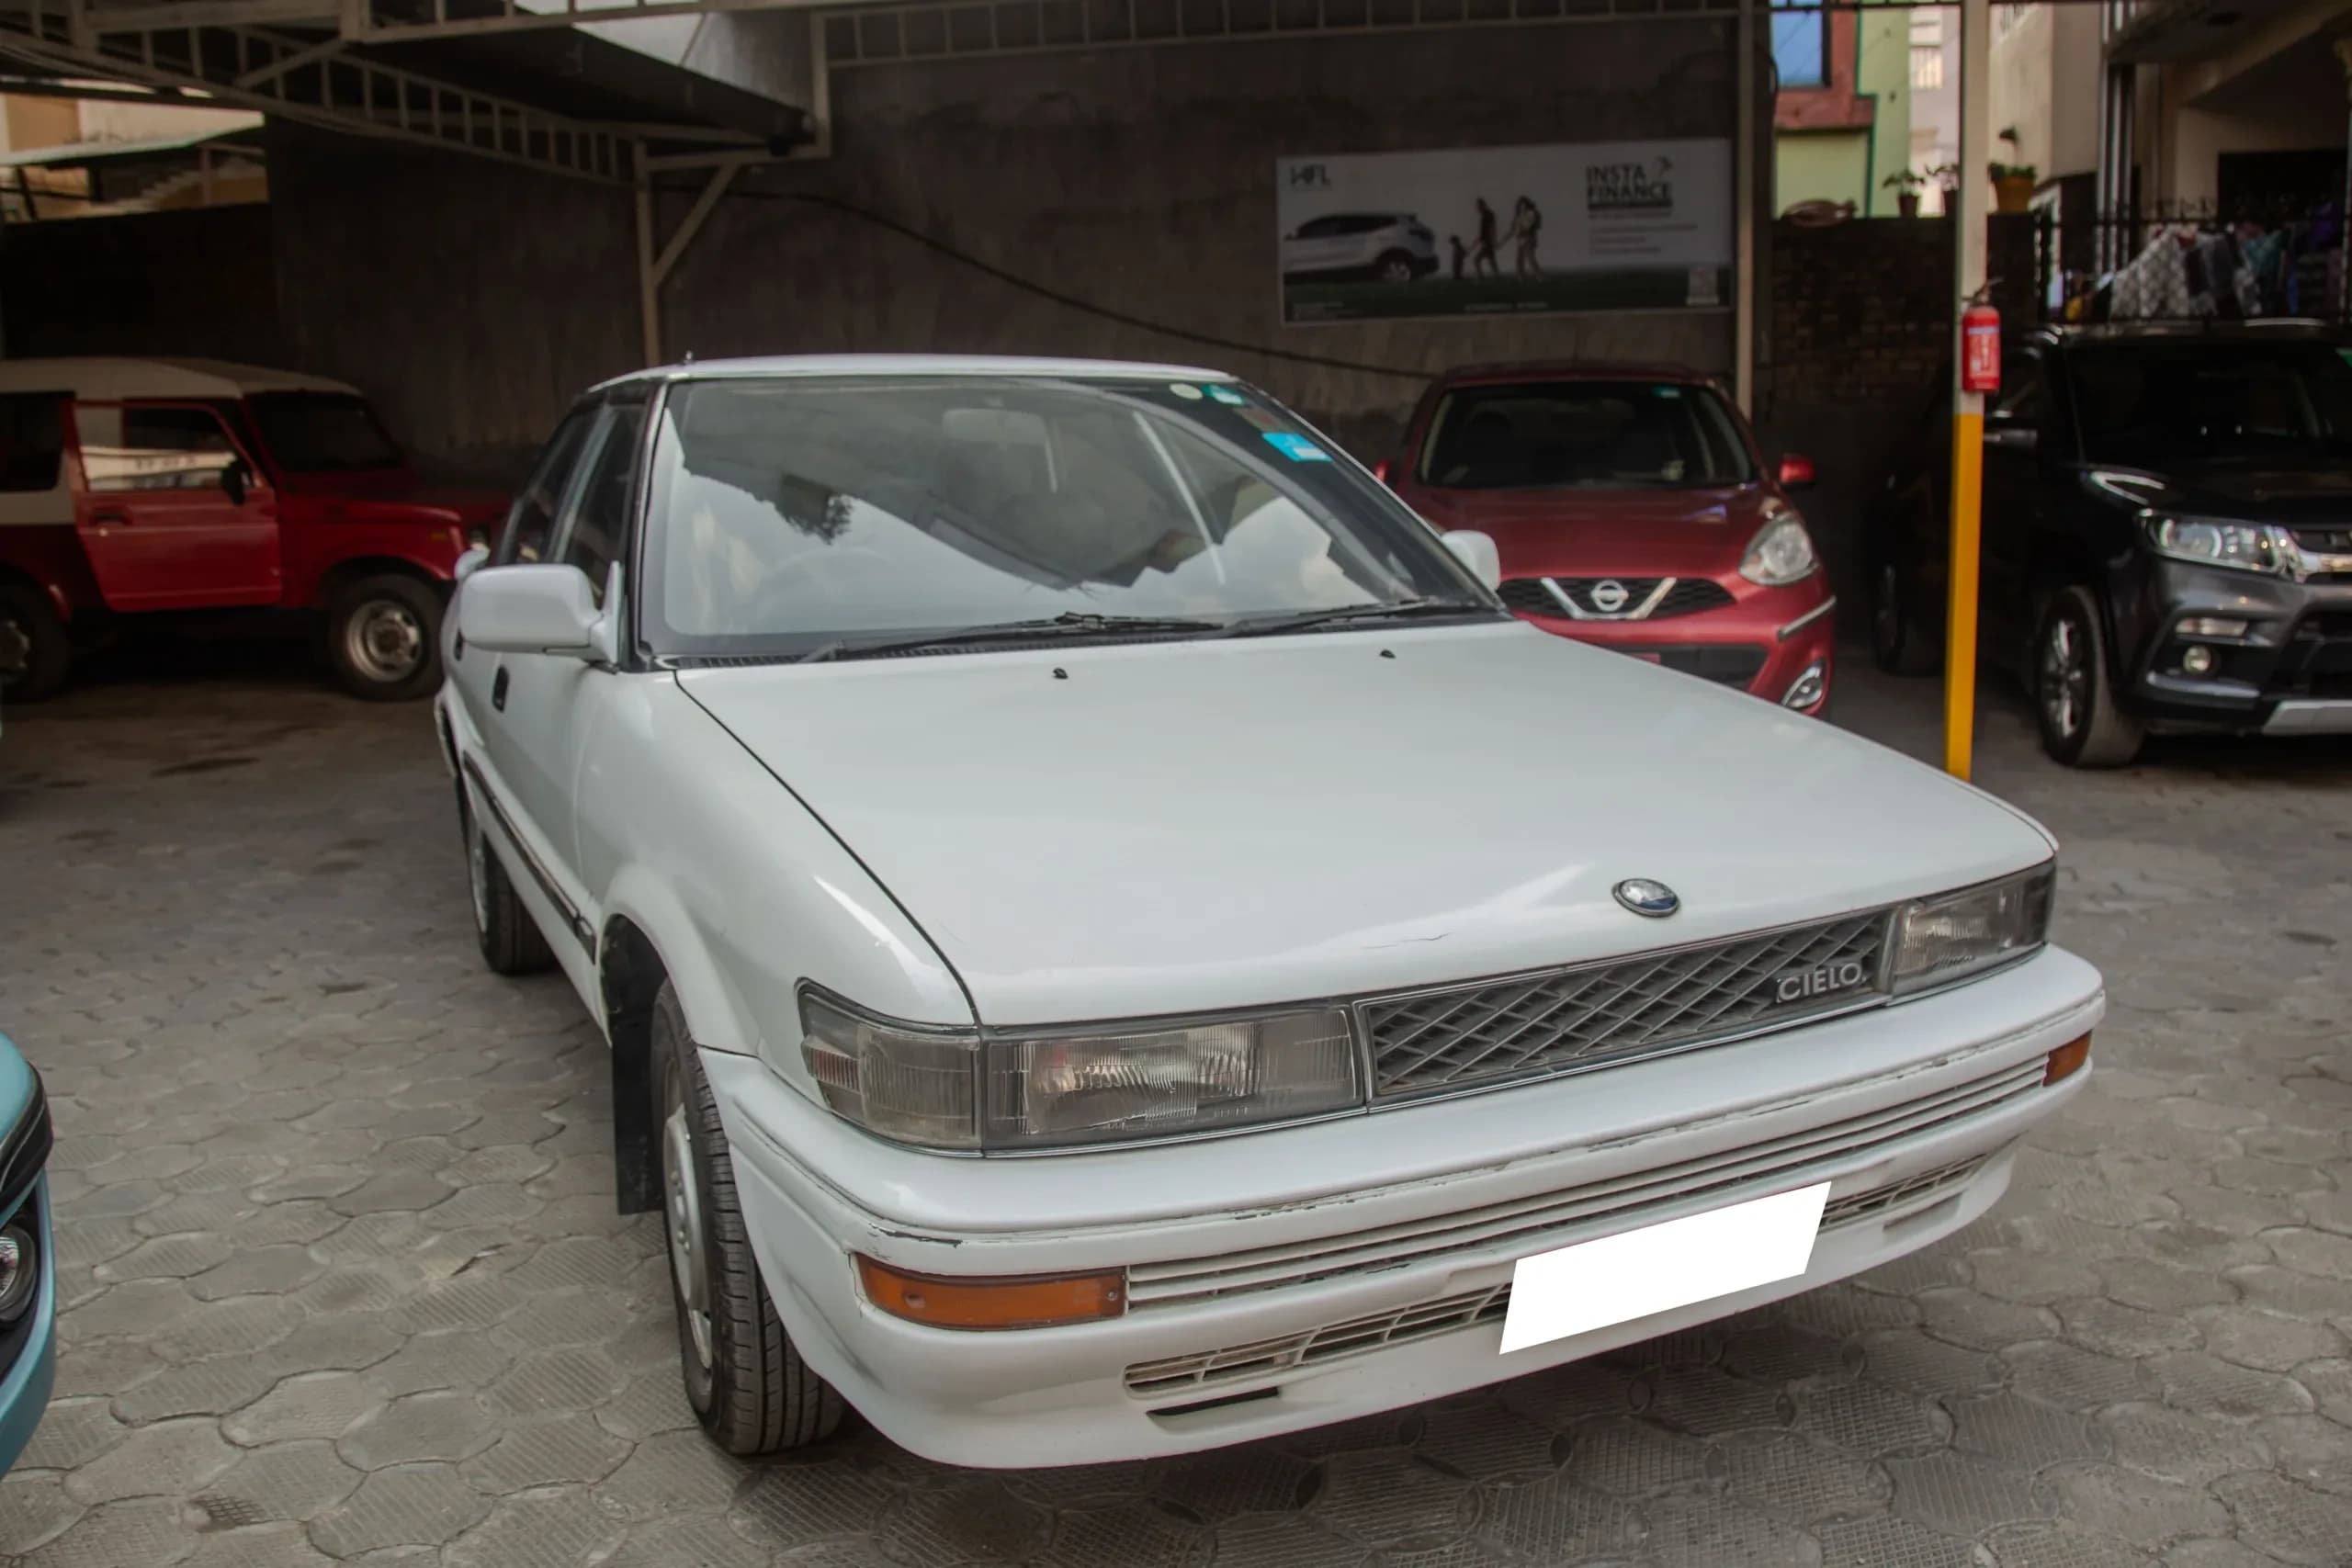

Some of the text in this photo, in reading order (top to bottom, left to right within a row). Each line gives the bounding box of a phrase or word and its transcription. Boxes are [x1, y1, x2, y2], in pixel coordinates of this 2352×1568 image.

[1587, 164, 1645, 185] INSTA
[1588, 182, 1672, 200] FINANCE
[1777, 962, 1862, 1001] CIELO
